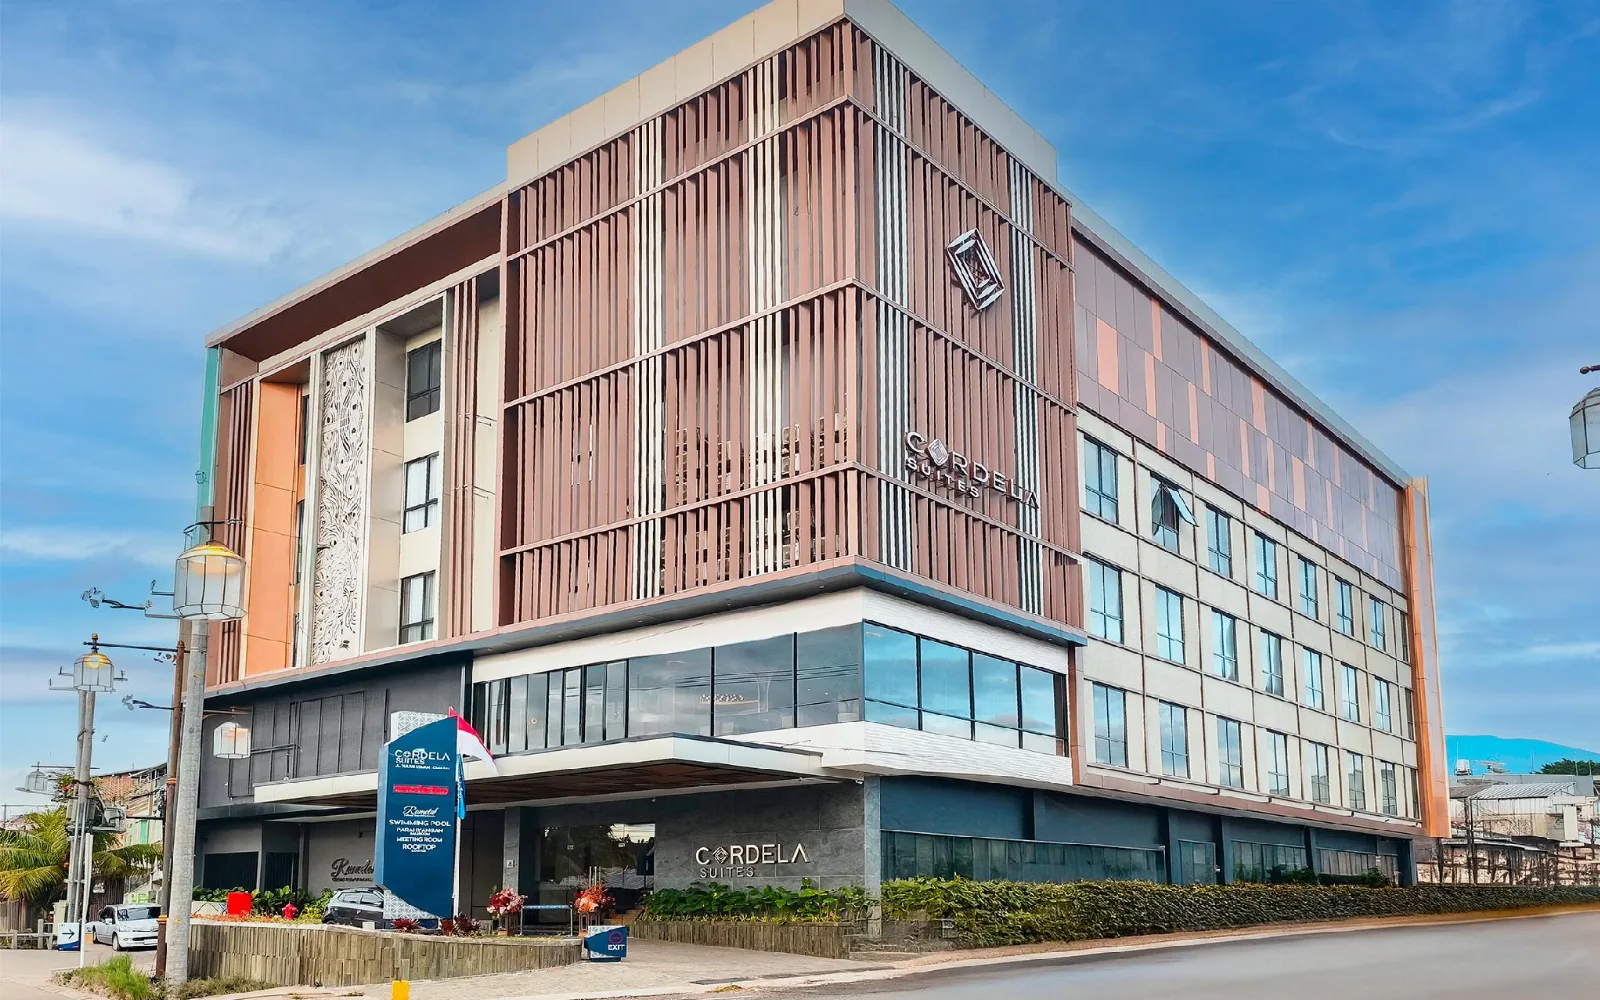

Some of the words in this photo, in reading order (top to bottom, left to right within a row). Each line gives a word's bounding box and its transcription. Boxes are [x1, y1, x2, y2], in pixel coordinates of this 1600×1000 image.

[904, 431, 1039, 509] CORDELA
[905, 457, 980, 499] SUITES
[395, 749, 450, 761] CORDELA
[396, 757, 425, 765] SUITES
[695, 843, 809, 865] CORDELA
[700, 866, 755, 878] SUITES
